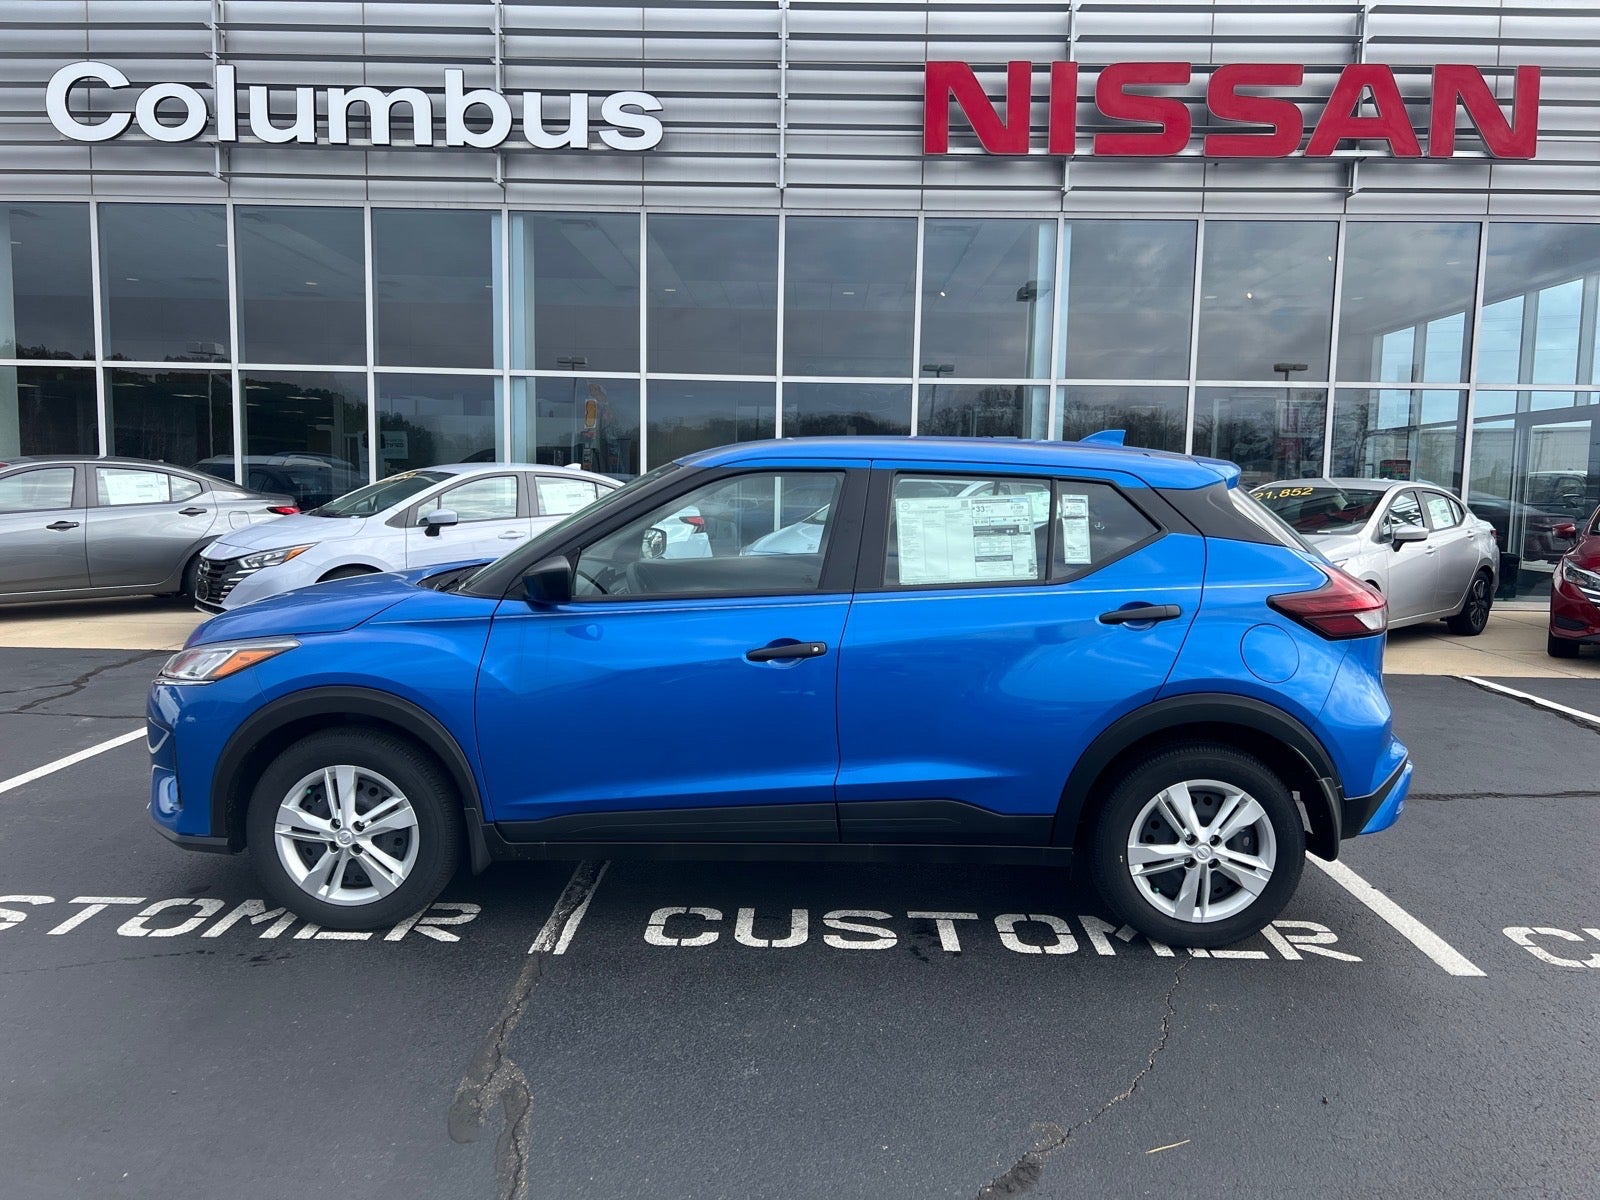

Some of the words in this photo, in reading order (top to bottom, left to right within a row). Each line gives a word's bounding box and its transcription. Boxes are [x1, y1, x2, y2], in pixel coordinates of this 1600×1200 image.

[45, 61, 664, 151] Columbus
[923, 60, 1541, 159] NISSAN
[644, 906, 1363, 962] CUSTOMR
